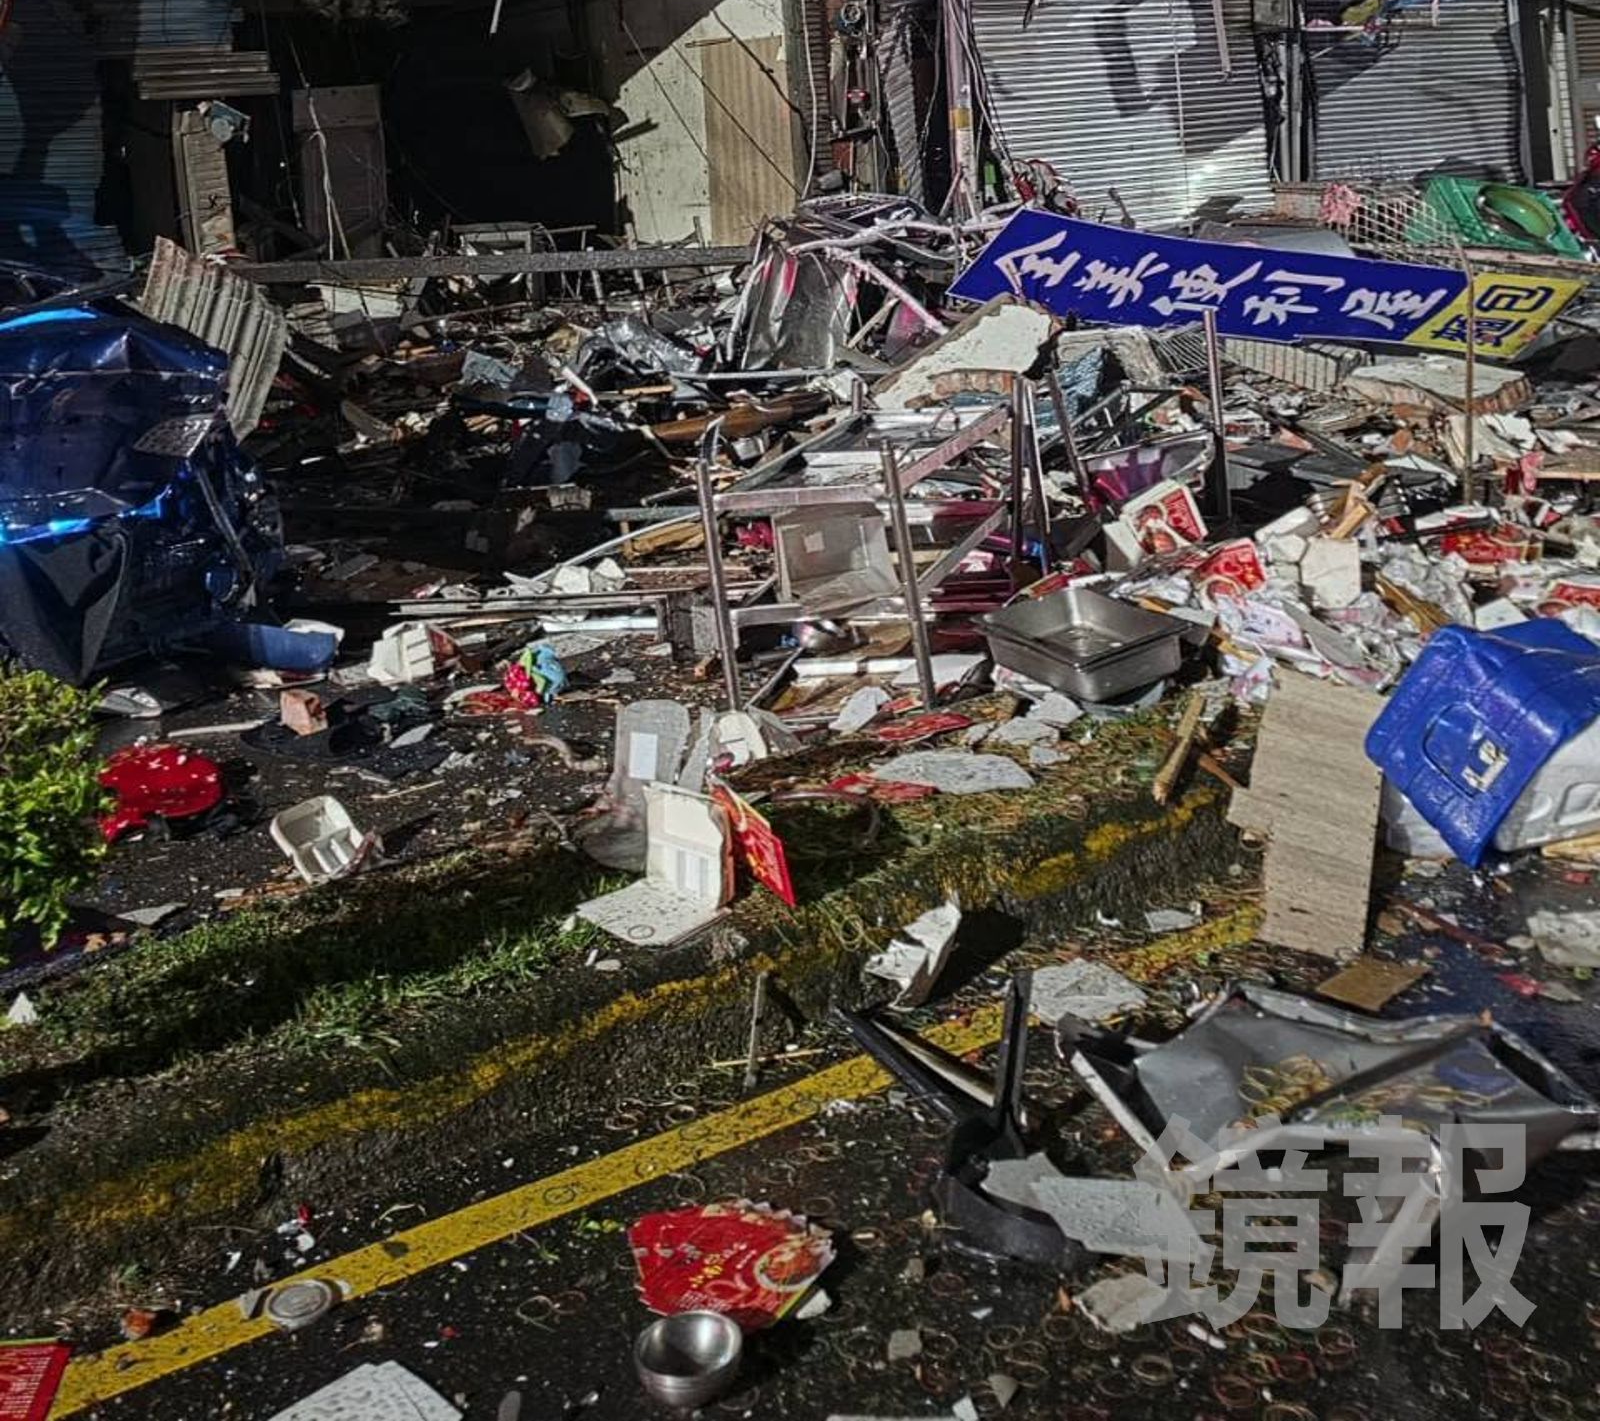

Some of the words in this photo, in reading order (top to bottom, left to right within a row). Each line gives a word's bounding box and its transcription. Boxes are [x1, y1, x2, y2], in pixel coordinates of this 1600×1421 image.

[994, 230, 1448, 330] 全美便利屋
